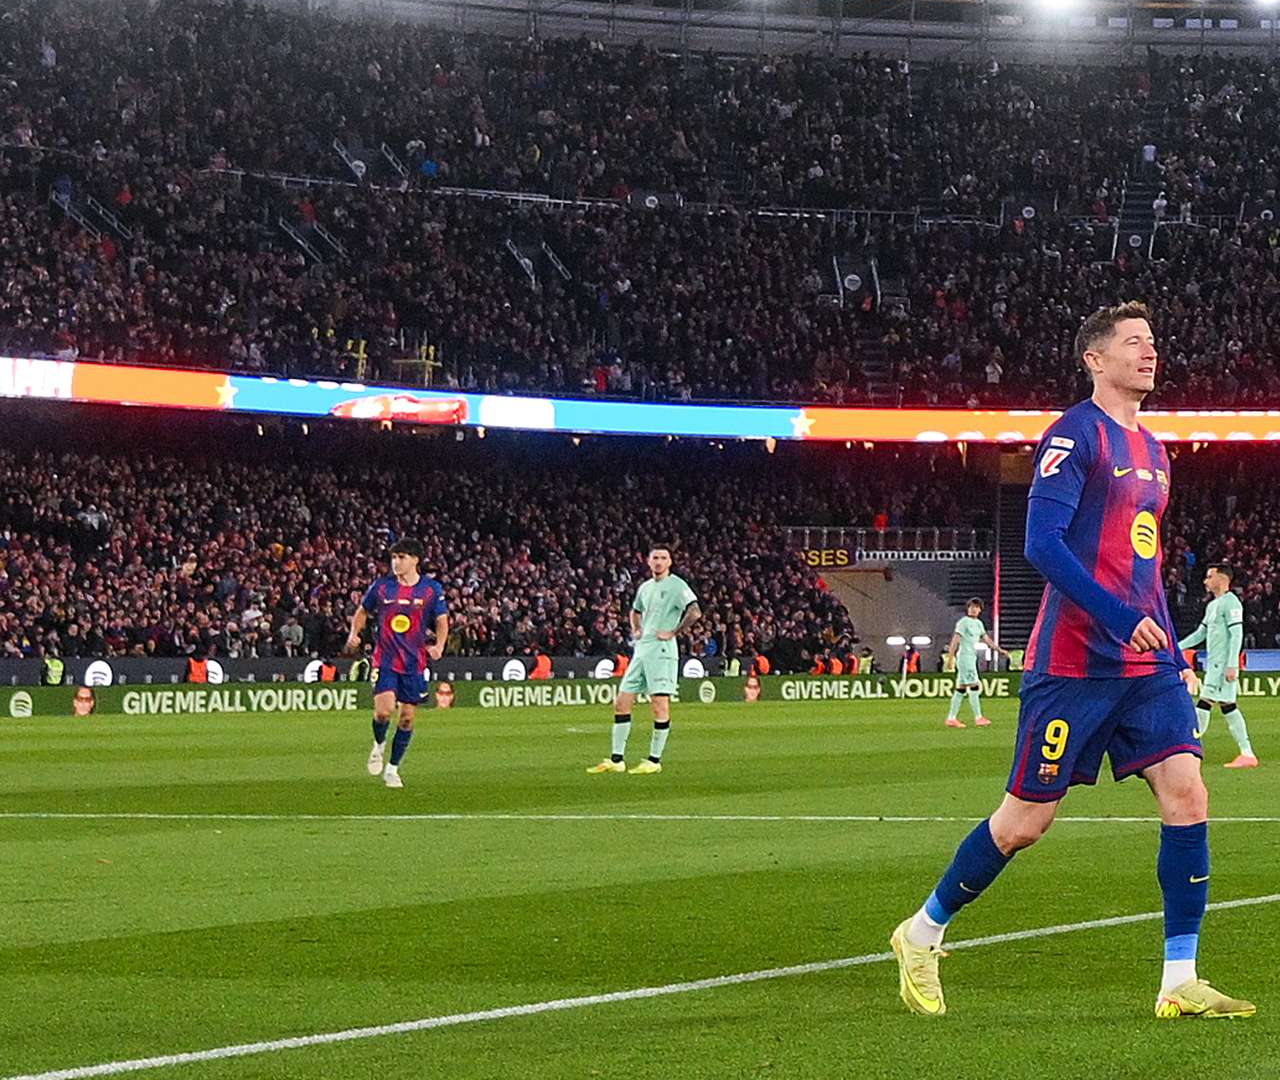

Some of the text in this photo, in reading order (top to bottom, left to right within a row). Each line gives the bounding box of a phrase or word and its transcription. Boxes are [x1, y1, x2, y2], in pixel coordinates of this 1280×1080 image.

[122, 688, 358, 714] GIVE ME ALL YOUR LOVE
[479, 687, 523, 708] GIVE
[524, 686, 552, 706] ME
[552, 685, 586, 705] ALL
[781, 678, 1009, 700] GIVE ME ALL YOUR OVE
[1041, 719, 1069, 760] 9
